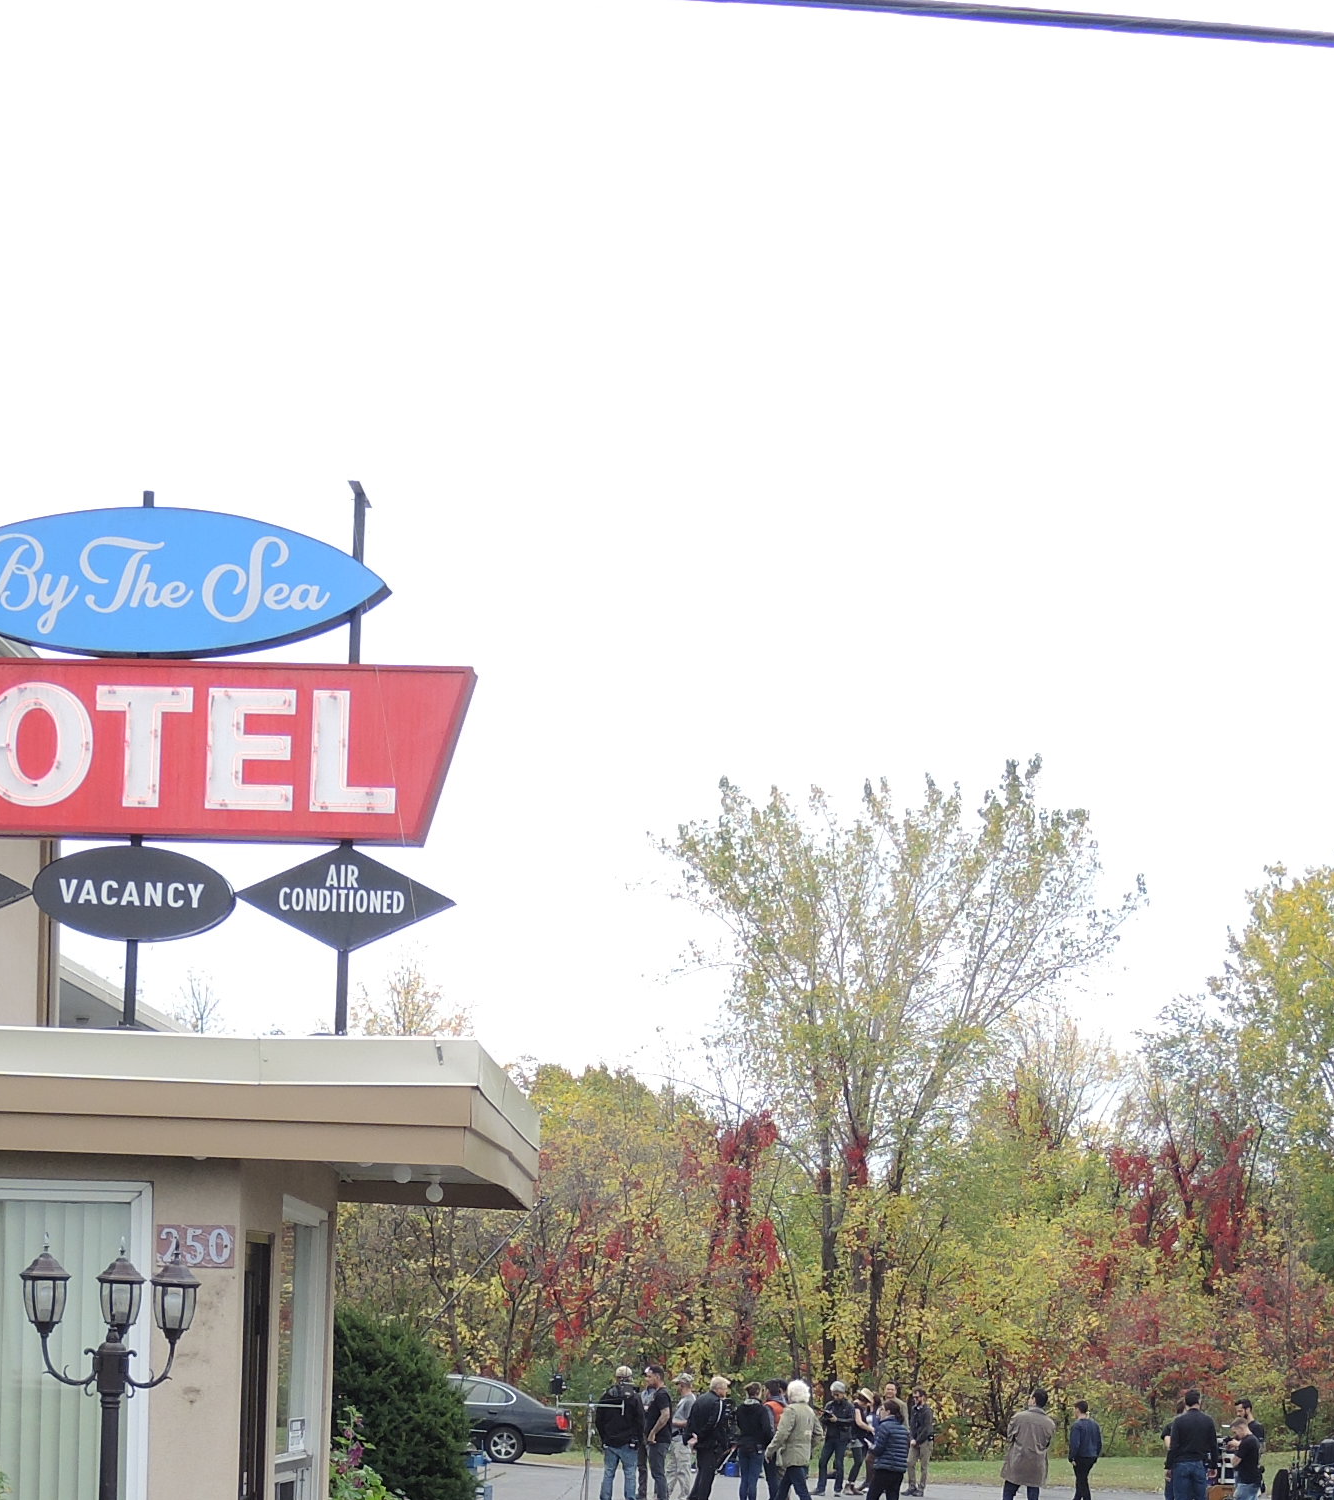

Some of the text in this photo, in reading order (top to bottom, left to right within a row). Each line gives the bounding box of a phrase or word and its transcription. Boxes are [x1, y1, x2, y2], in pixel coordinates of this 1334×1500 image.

[79, 536, 194, 613] The
[202, 536, 330, 623] Sea
[325, 864, 360, 888] AIR
[59, 878, 205, 909] VACANCY
[278, 888, 405, 915] CONDITIONED
[160, 1228, 231, 1264] 250
